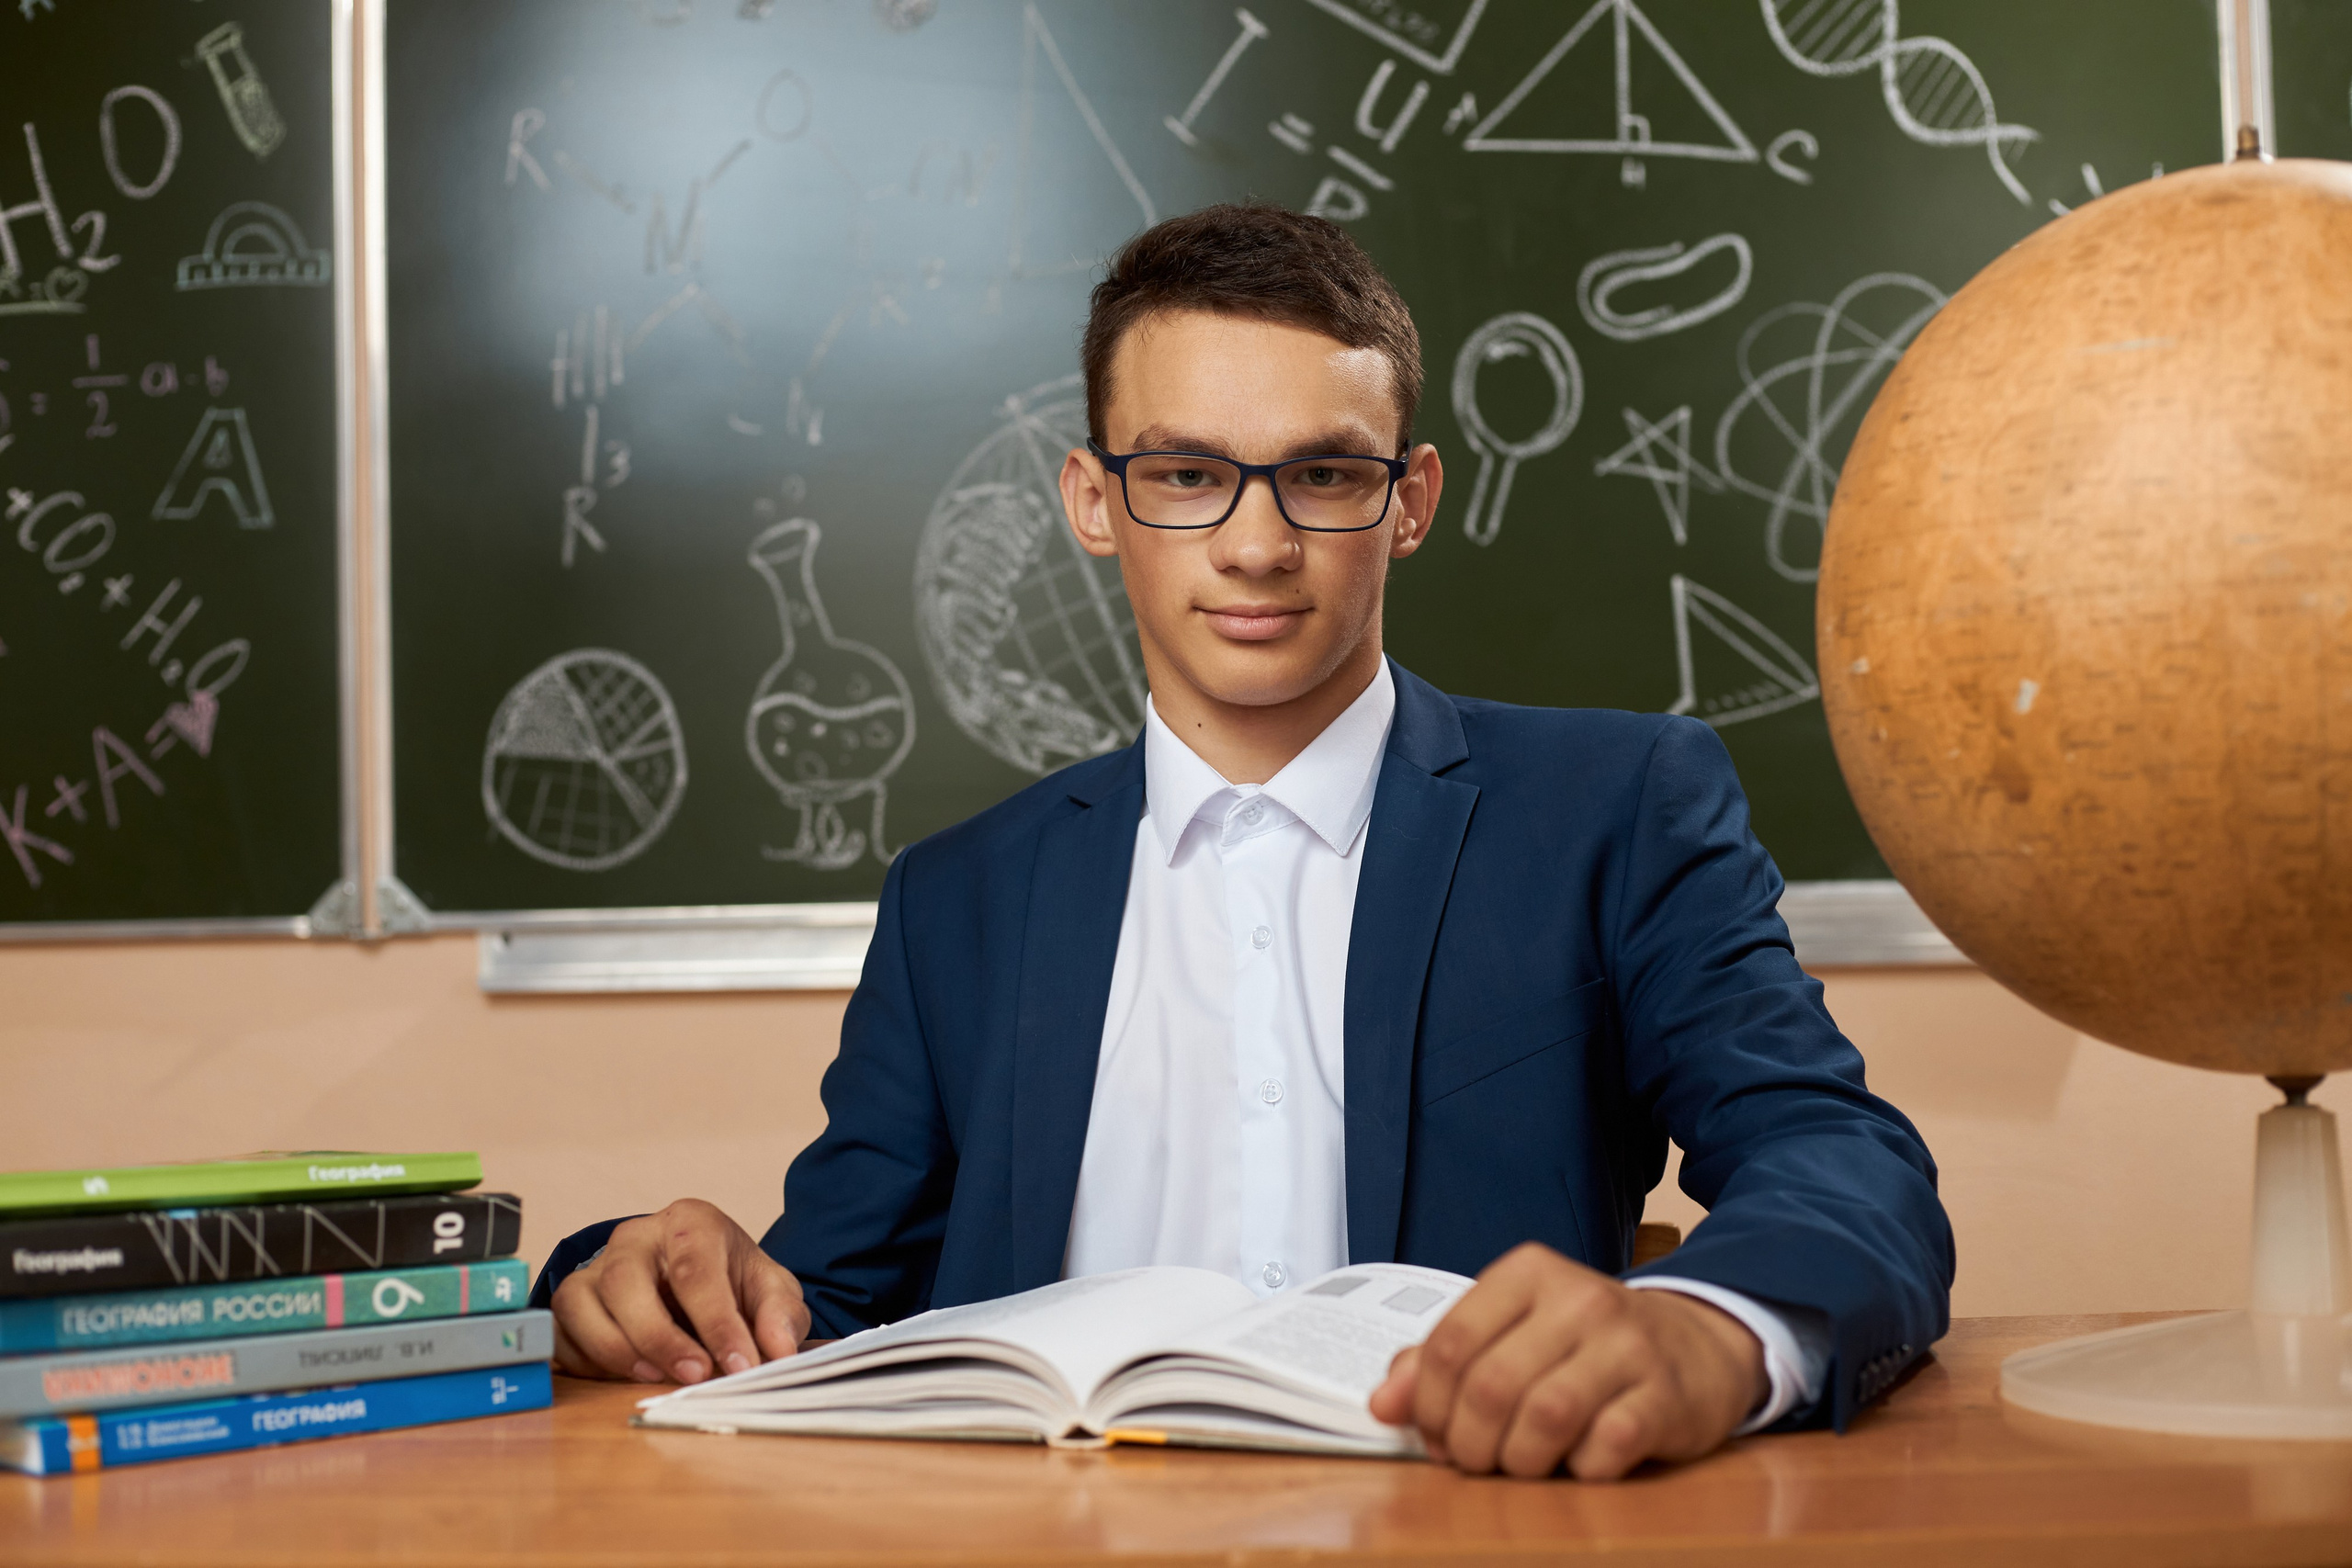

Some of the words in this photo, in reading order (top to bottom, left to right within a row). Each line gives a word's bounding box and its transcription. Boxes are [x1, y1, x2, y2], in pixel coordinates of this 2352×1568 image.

[504, 107, 552, 193] R
[561, 485, 608, 568] R
[307, 1163, 407, 1183] География
[12, 1246, 125, 1276] География
[433, 1211, 466, 1255] 10
[62, 1298, 205, 1337] ГЕОГРАФИЯ
[211, 1292, 322, 1323] РОССИИ
[251, 1397, 368, 1432] ГЕОГРАФИЯ
